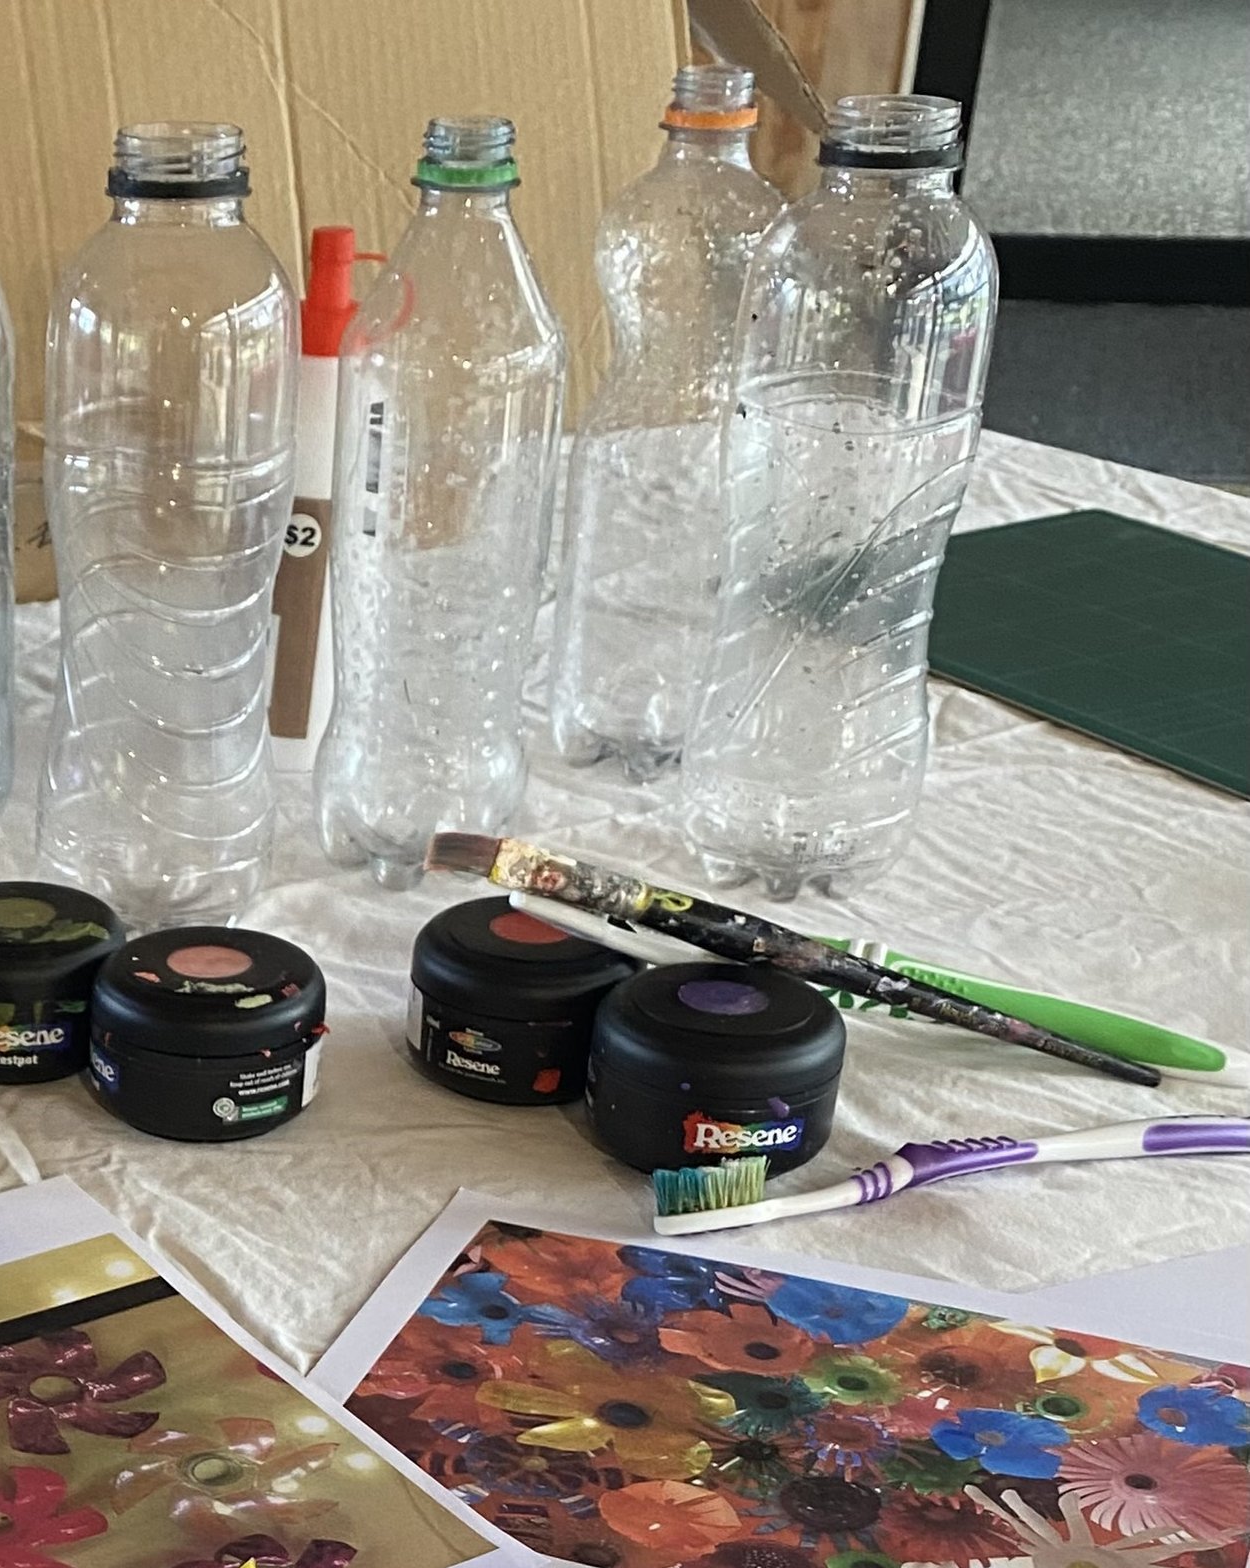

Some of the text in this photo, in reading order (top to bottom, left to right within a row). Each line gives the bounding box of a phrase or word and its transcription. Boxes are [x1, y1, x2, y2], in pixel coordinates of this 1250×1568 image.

[284, 524, 316, 548] $2
[446, 1050, 501, 1076] Resene
[693, 1123, 798, 1149] Resene
